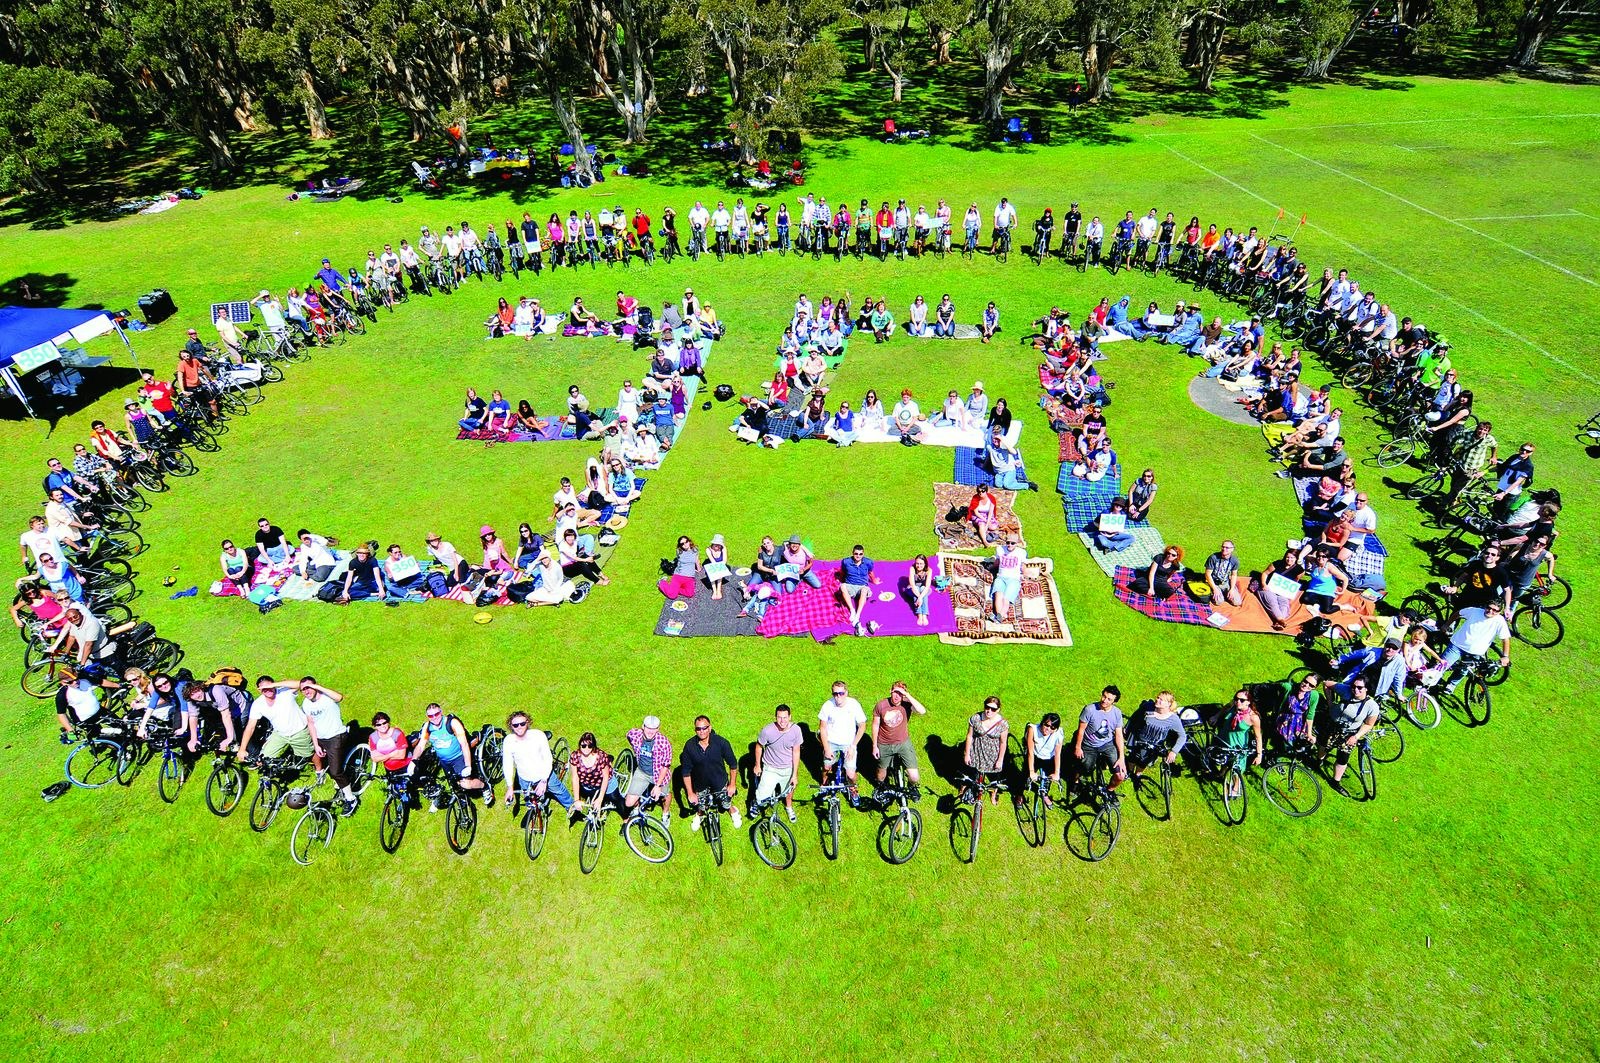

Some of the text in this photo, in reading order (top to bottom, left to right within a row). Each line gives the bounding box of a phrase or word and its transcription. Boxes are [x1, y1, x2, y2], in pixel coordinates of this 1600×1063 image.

[19, 341, 57, 368] 350
[1101, 515, 1125, 526] 350
[391, 558, 416, 573] 350
[777, 564, 799, 575] 350
[1272, 576, 1298, 593] 350
